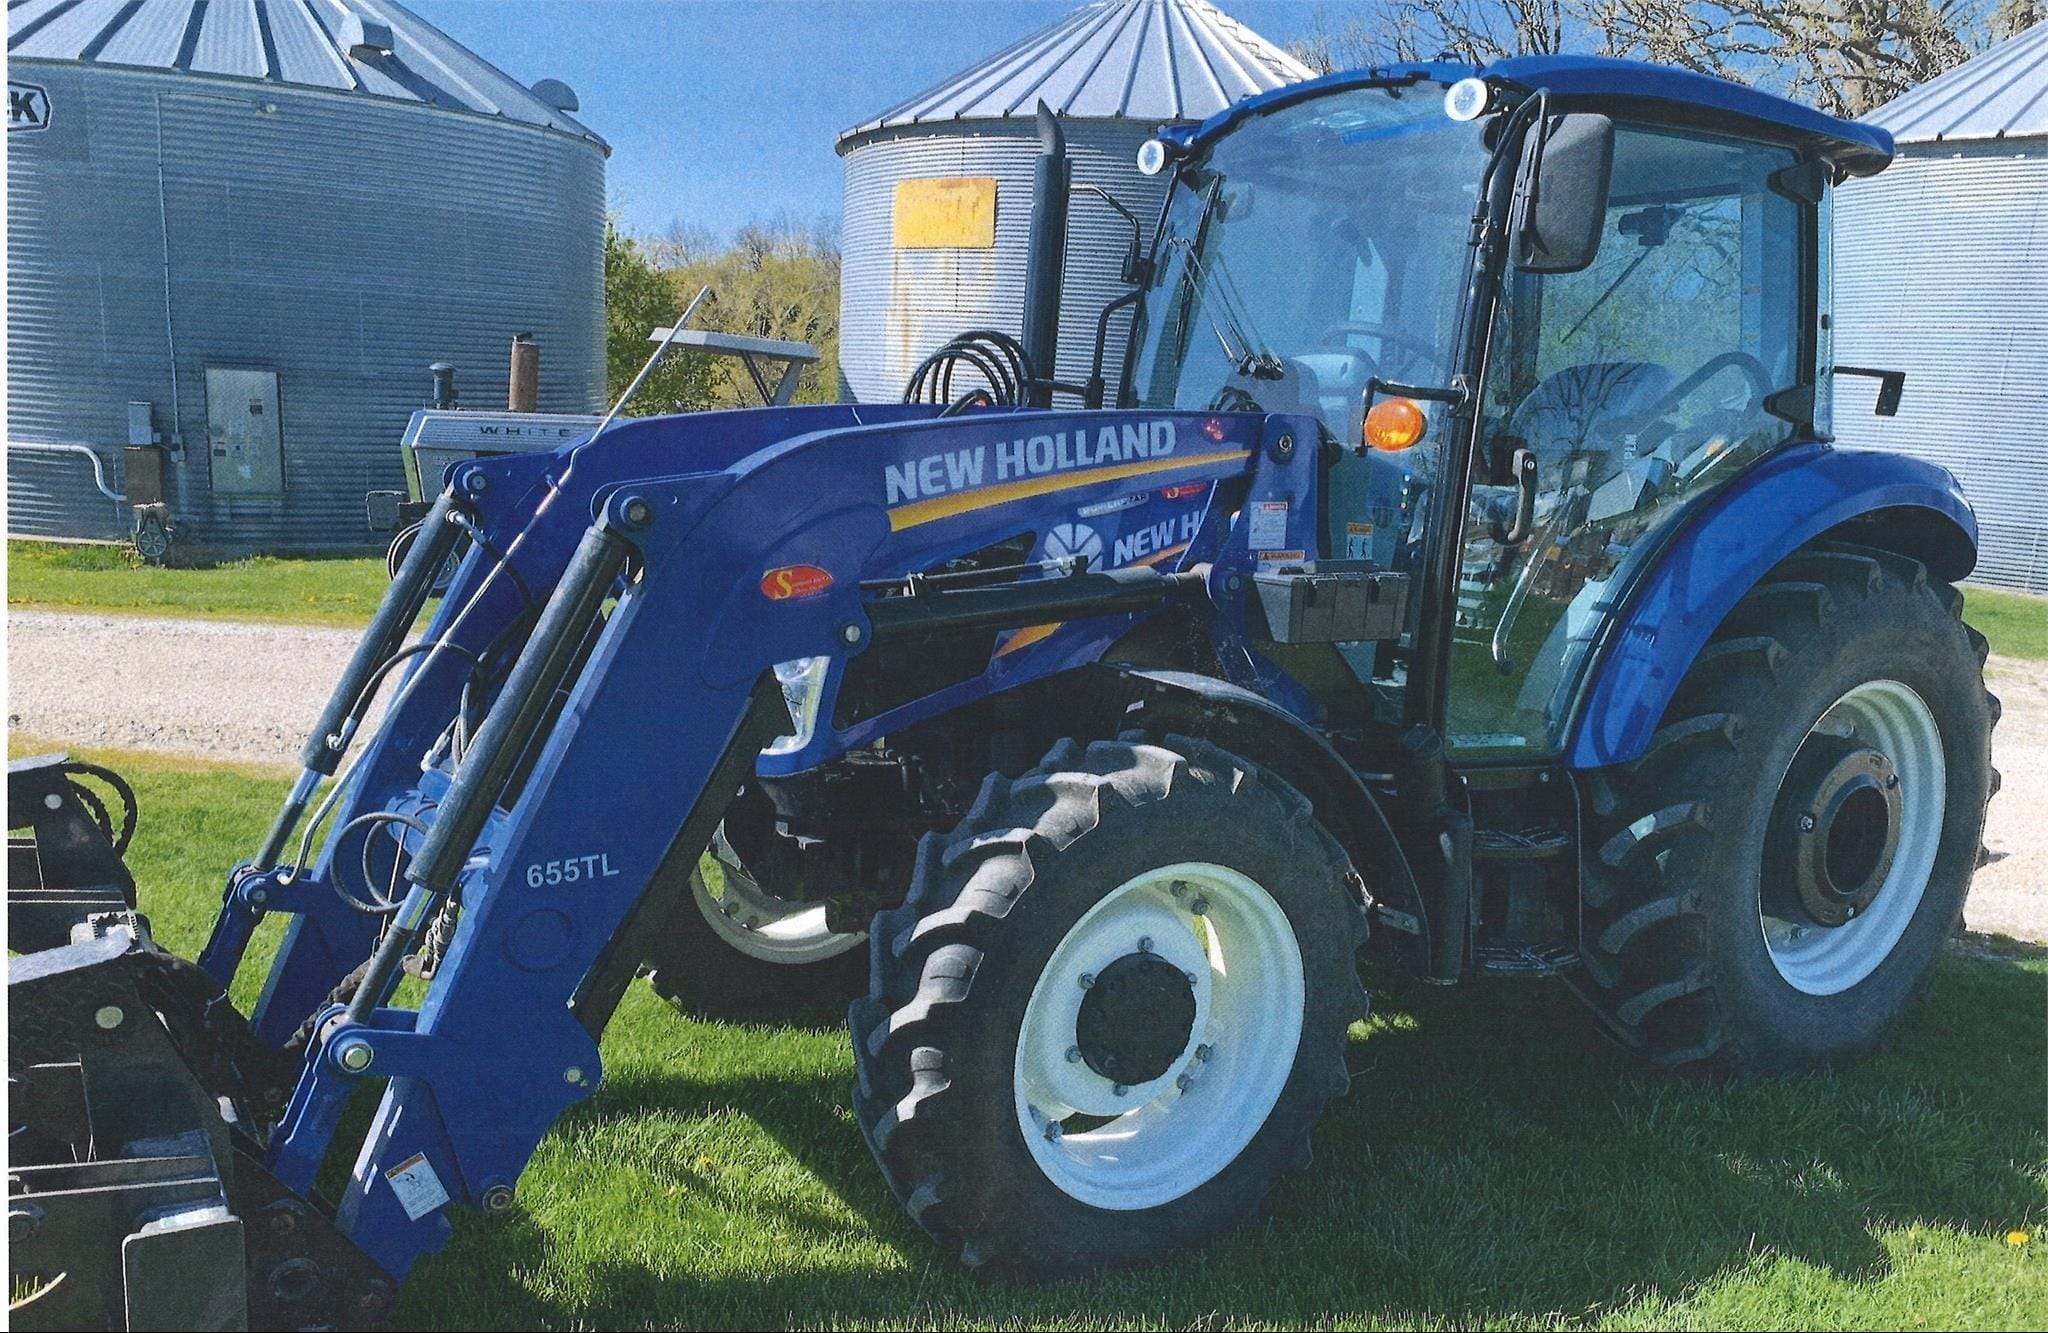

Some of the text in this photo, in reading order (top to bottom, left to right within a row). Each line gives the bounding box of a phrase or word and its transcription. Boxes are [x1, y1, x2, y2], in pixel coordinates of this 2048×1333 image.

[8, 91, 40, 123] K
[480, 426, 570, 437] WHITE
[884, 420, 1177, 505] NEW HOLLAND
[1113, 518, 1176, 567] NEW
[1181, 508, 1206, 540] H
[526, 853, 620, 889] 655TL
